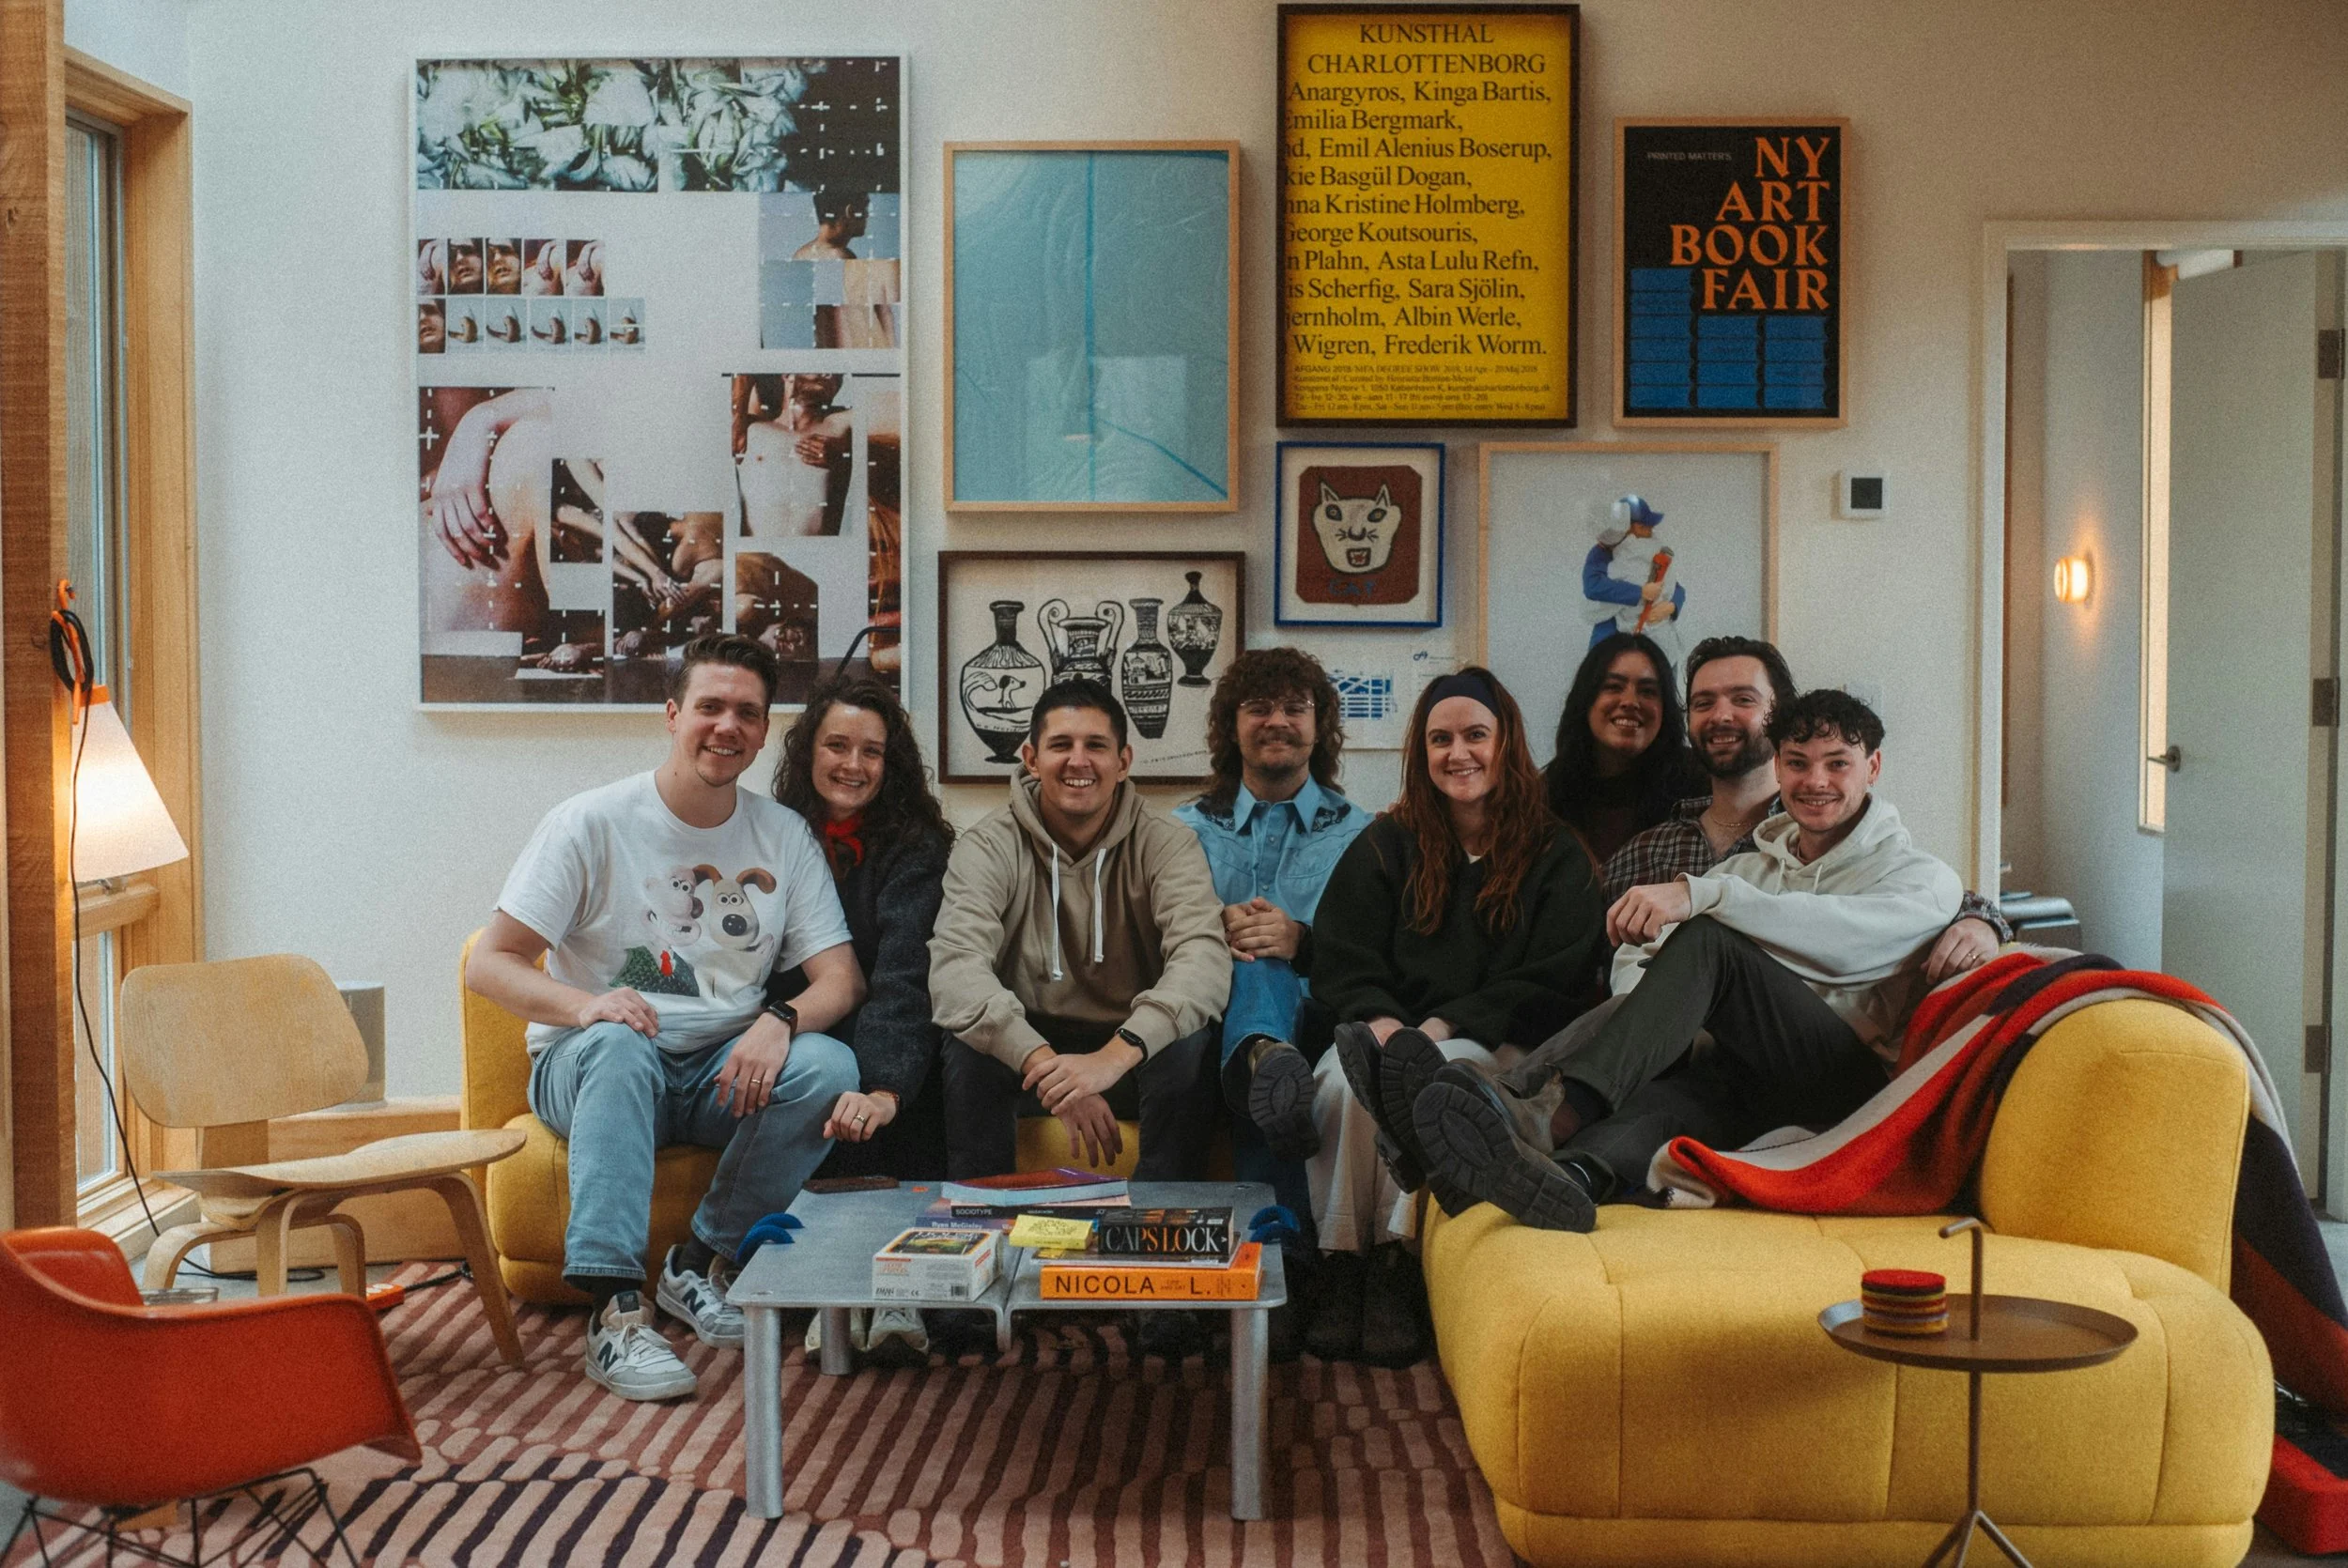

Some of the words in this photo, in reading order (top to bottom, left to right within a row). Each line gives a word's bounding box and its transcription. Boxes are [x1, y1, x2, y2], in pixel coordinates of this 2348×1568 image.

[1360, 23, 1494, 43] KUNSTHAL
[1307, 54, 1546, 74] CHARLOTTENBORG
[1288, 82, 1406, 106] Anargyros,
[1413, 81, 1477, 106] Kinga
[1483, 81, 1552, 103] Bartis,
[1352, 110, 1463, 134] Bergmark,
[1320, 137, 1369, 158] Emil
[1375, 137, 1454, 158] Alenius
[1460, 138, 1552, 162] Boserup,
[1647, 152, 1687, 161] PRINTED
[1754, 136, 1831, 178] NY
[1321, 165, 1391, 191] Basgül
[1398, 166, 1473, 191] Dogan,
[1326, 193, 1411, 214] Kristine
[1415, 193, 1525, 219] Holmberg,
[1715, 180, 1830, 222] ART
[1359, 222, 1479, 244] Koutsouris,
[1670, 224, 1829, 267] BOOK
[1305, 251, 1370, 272] Plahn,
[1378, 251, 1427, 270] Asta
[1431, 251, 1478, 270] Lulu
[1483, 249, 1540, 272] Refn,
[1308, 278, 1400, 303] Scherfig,
[1409, 279, 1455, 299] Sara
[1460, 278, 1526, 303] Sjölin,
[1701, 269, 1830, 310] FAIR
[1393, 306, 1453, 327] Albin
[1457, 306, 1522, 330] Werle,
[1294, 334, 1377, 360] Wigren,
[1384, 333, 1473, 355] Frederik
[1477, 334, 1548, 355] Worm.
[932, 1222, 949, 1230] Ryan
[1055, 1275, 1155, 1296] NICOLA
[1190, 1276, 1211, 1296] L.
